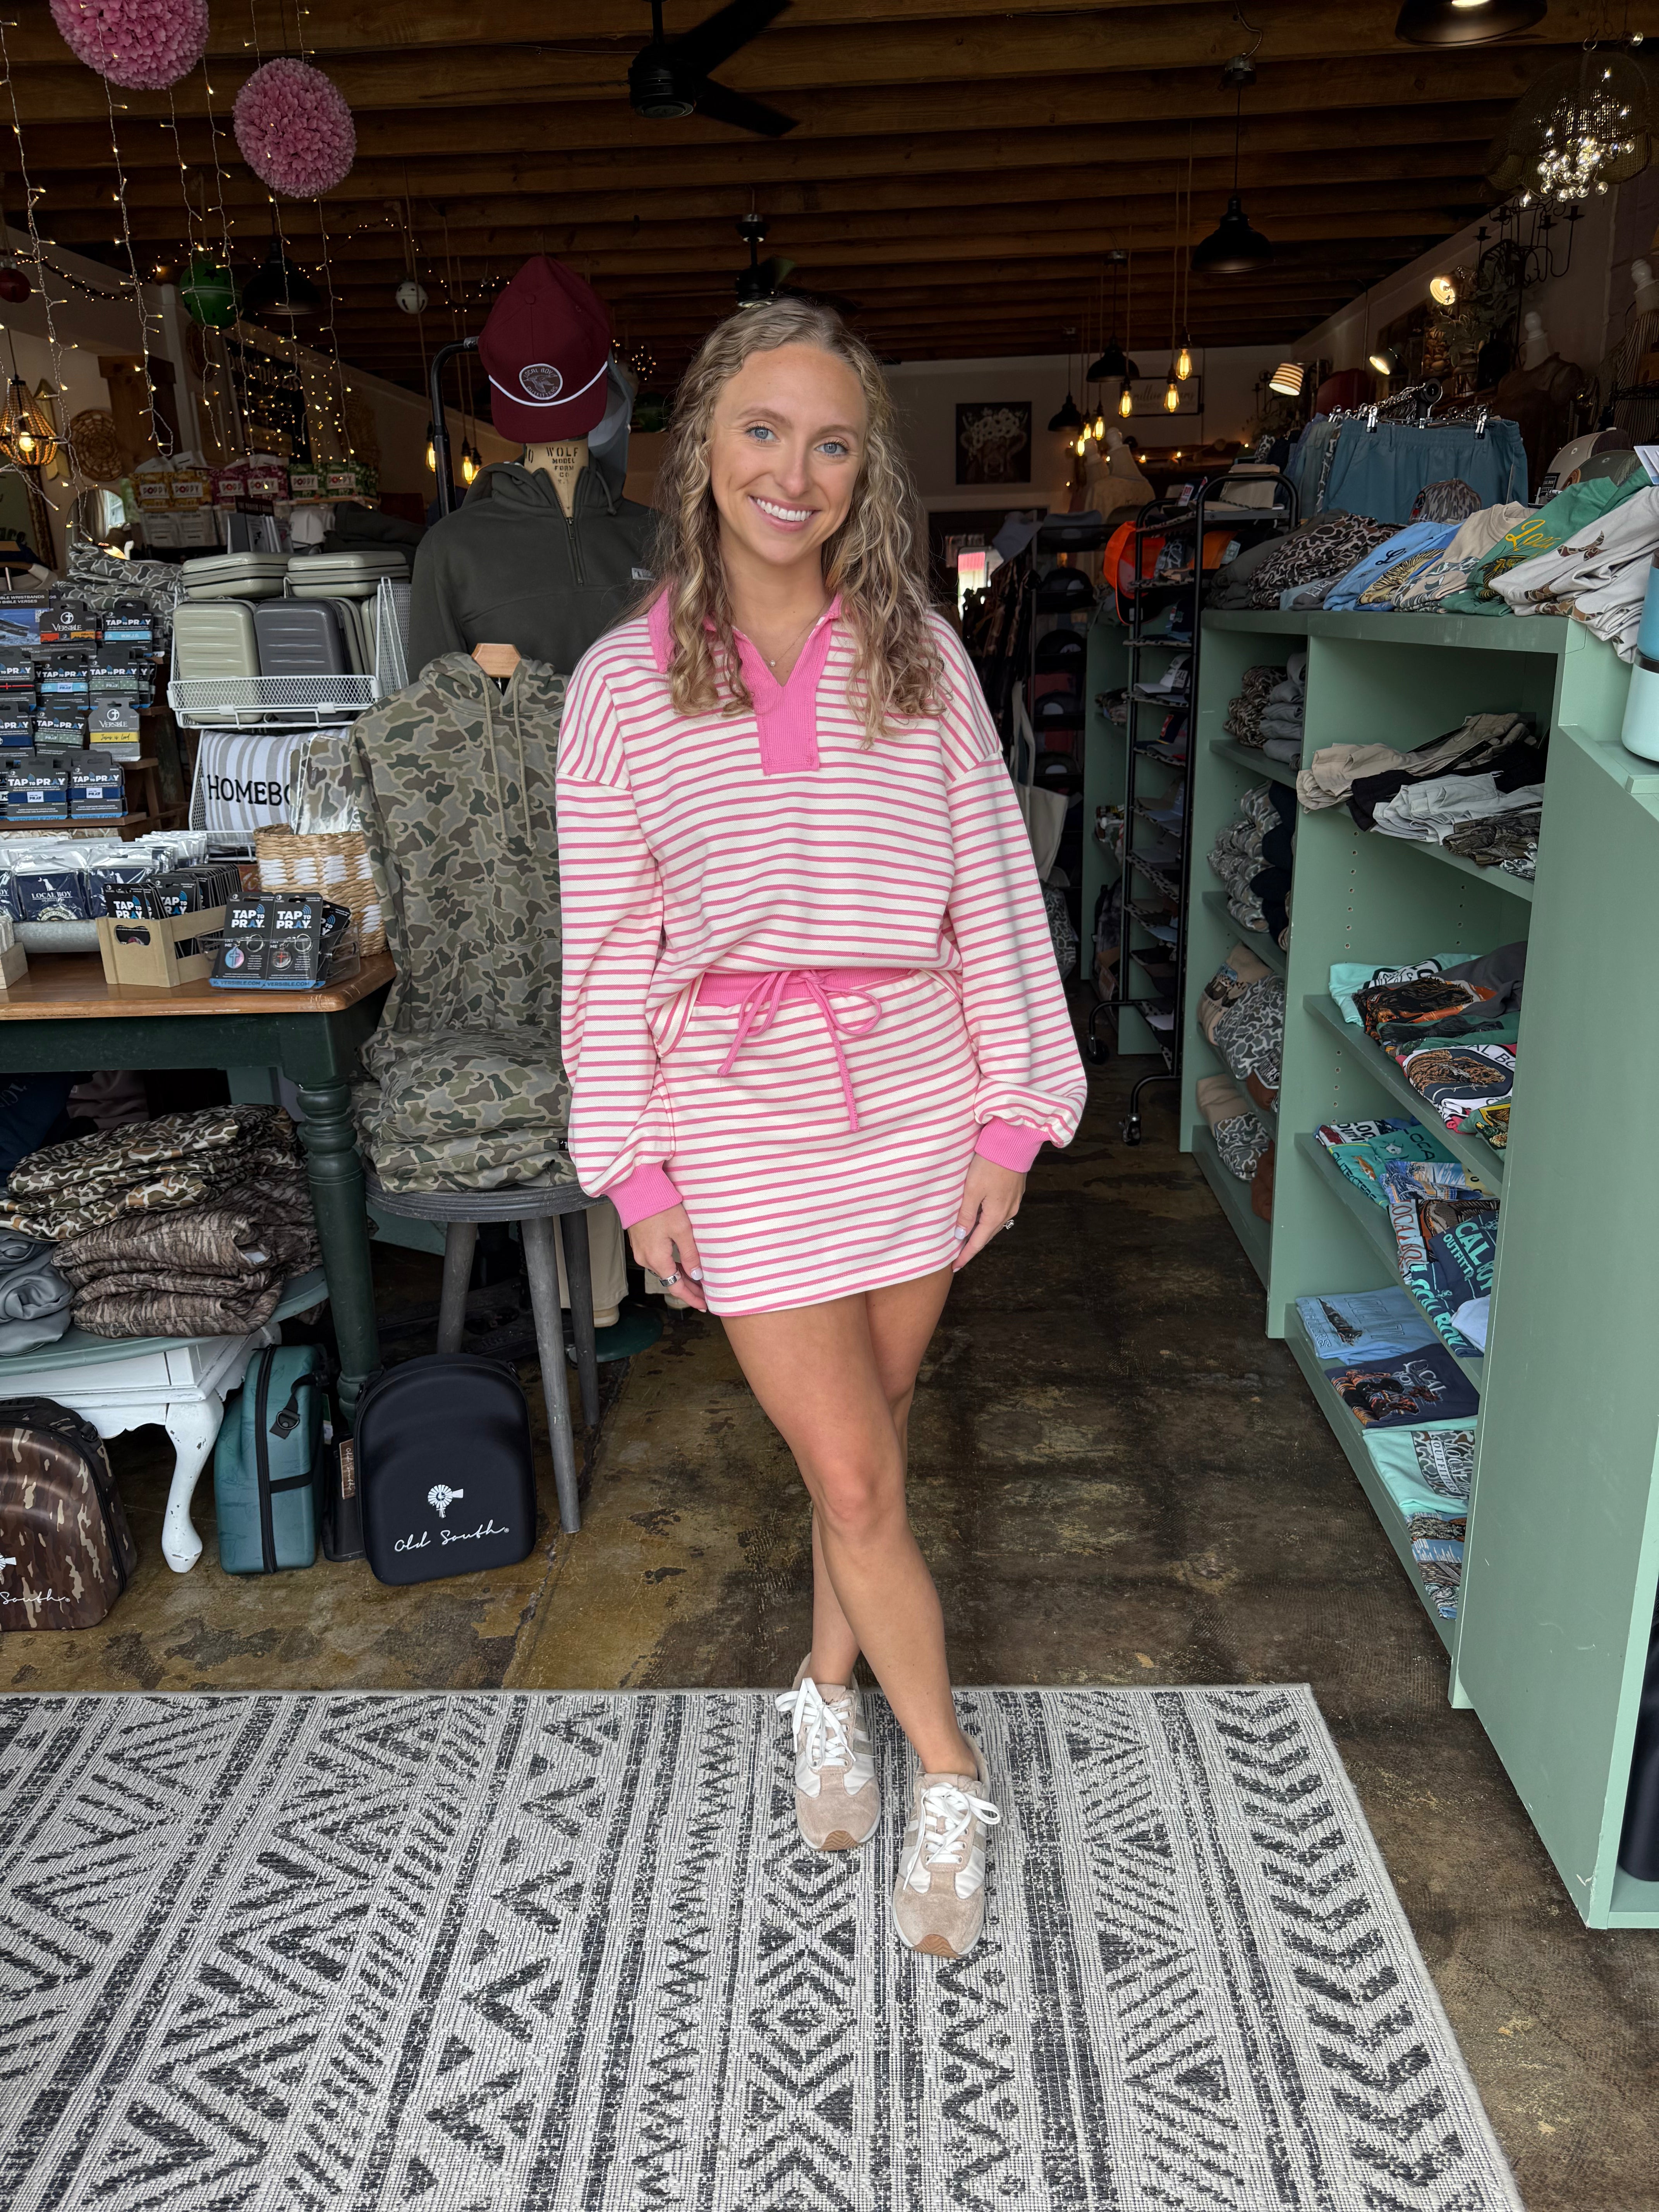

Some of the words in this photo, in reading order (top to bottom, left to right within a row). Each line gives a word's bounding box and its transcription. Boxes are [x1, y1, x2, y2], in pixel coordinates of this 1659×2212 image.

[546, 447, 578, 456] WOLF
[52, 623, 82, 631] VERSIBLE
[113, 901, 134, 910] TAP
[161, 897, 180, 905] TAP
[115, 910, 143, 919] PRAY
[233, 910, 256, 919] TAP
[277, 911, 303, 920] TAP
[231, 919, 264, 928] PRAY
[276, 920, 311, 929] PRAY
[1455, 1222, 1489, 1266] CAL
[394, 1531, 431, 1553] Old
